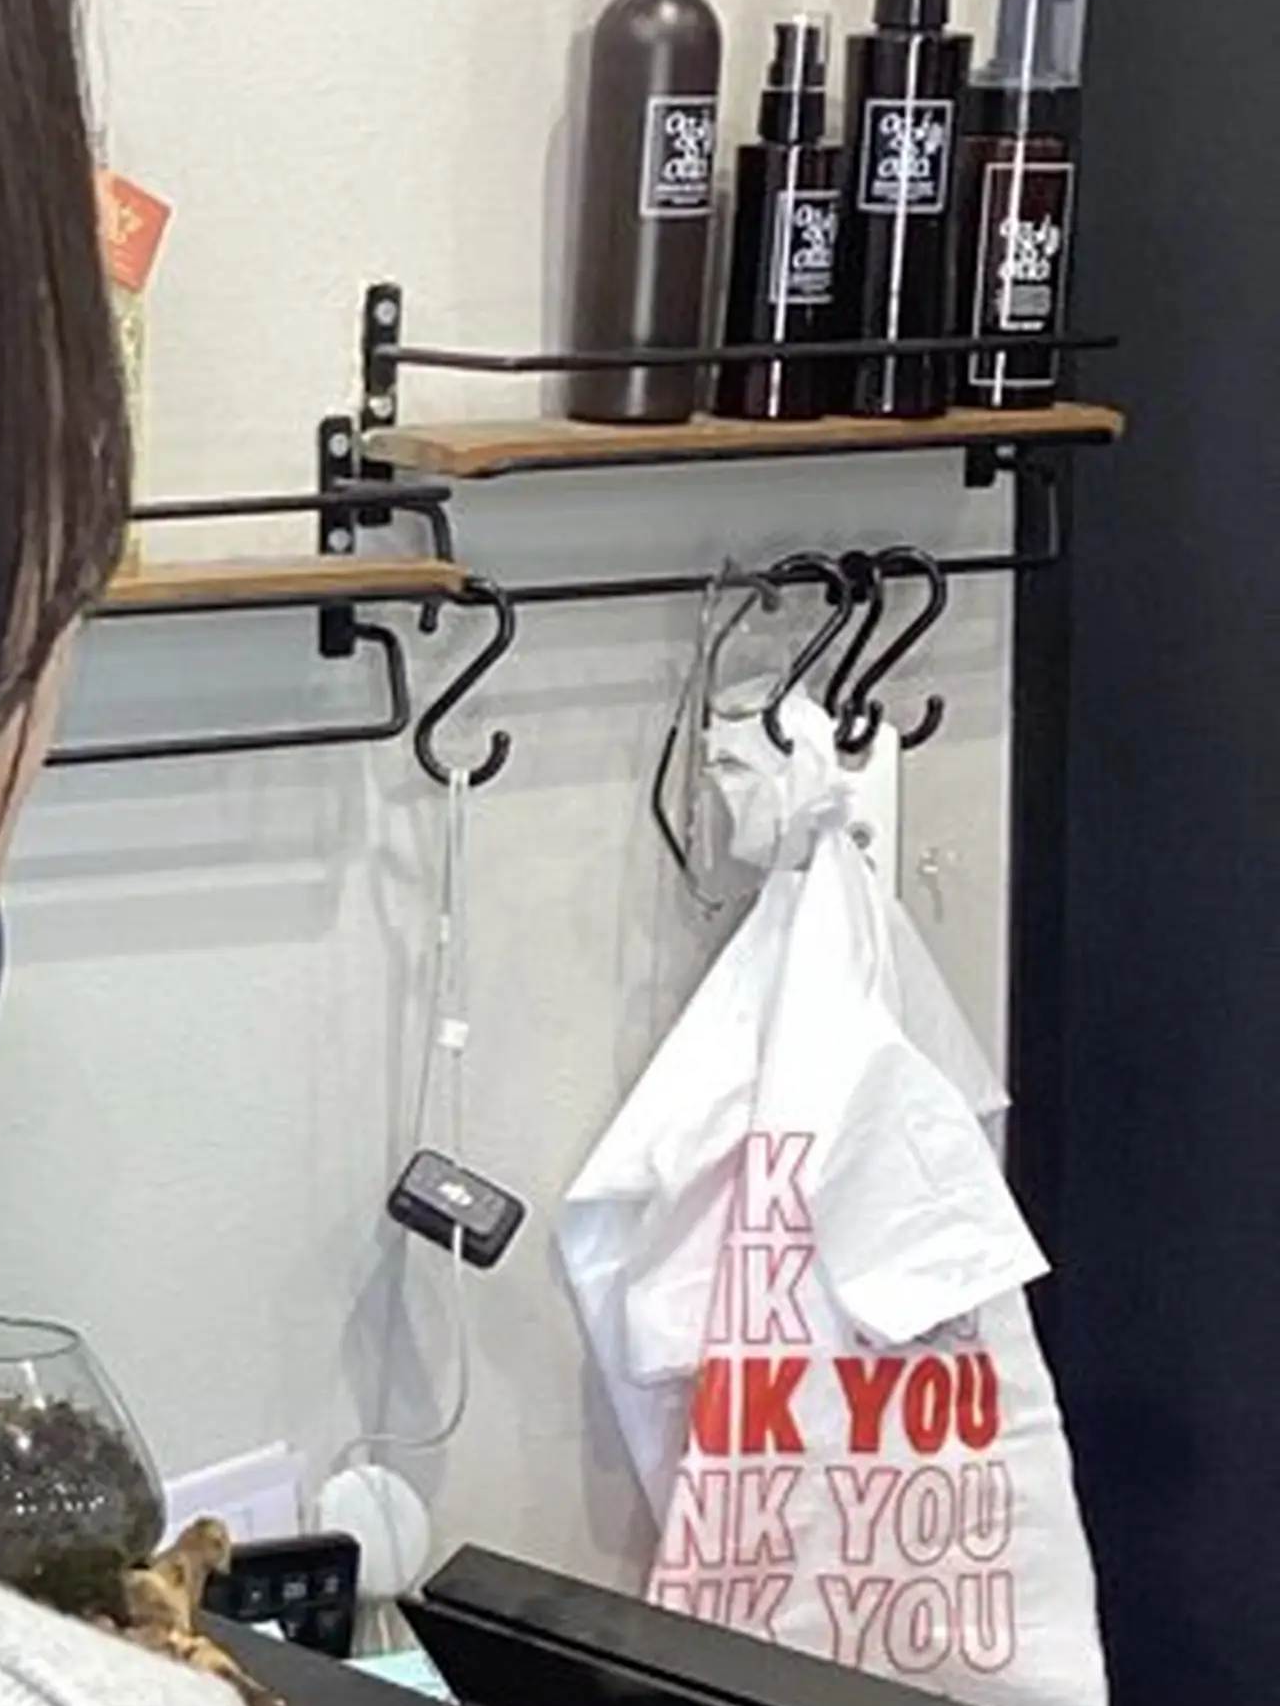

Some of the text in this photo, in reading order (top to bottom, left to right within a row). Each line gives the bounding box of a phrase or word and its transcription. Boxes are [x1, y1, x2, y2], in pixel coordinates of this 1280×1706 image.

[834, 1350, 1000, 1455] YOU
[825, 1460, 1013, 1567] YOU
[816, 1569, 1017, 1675] YOU
